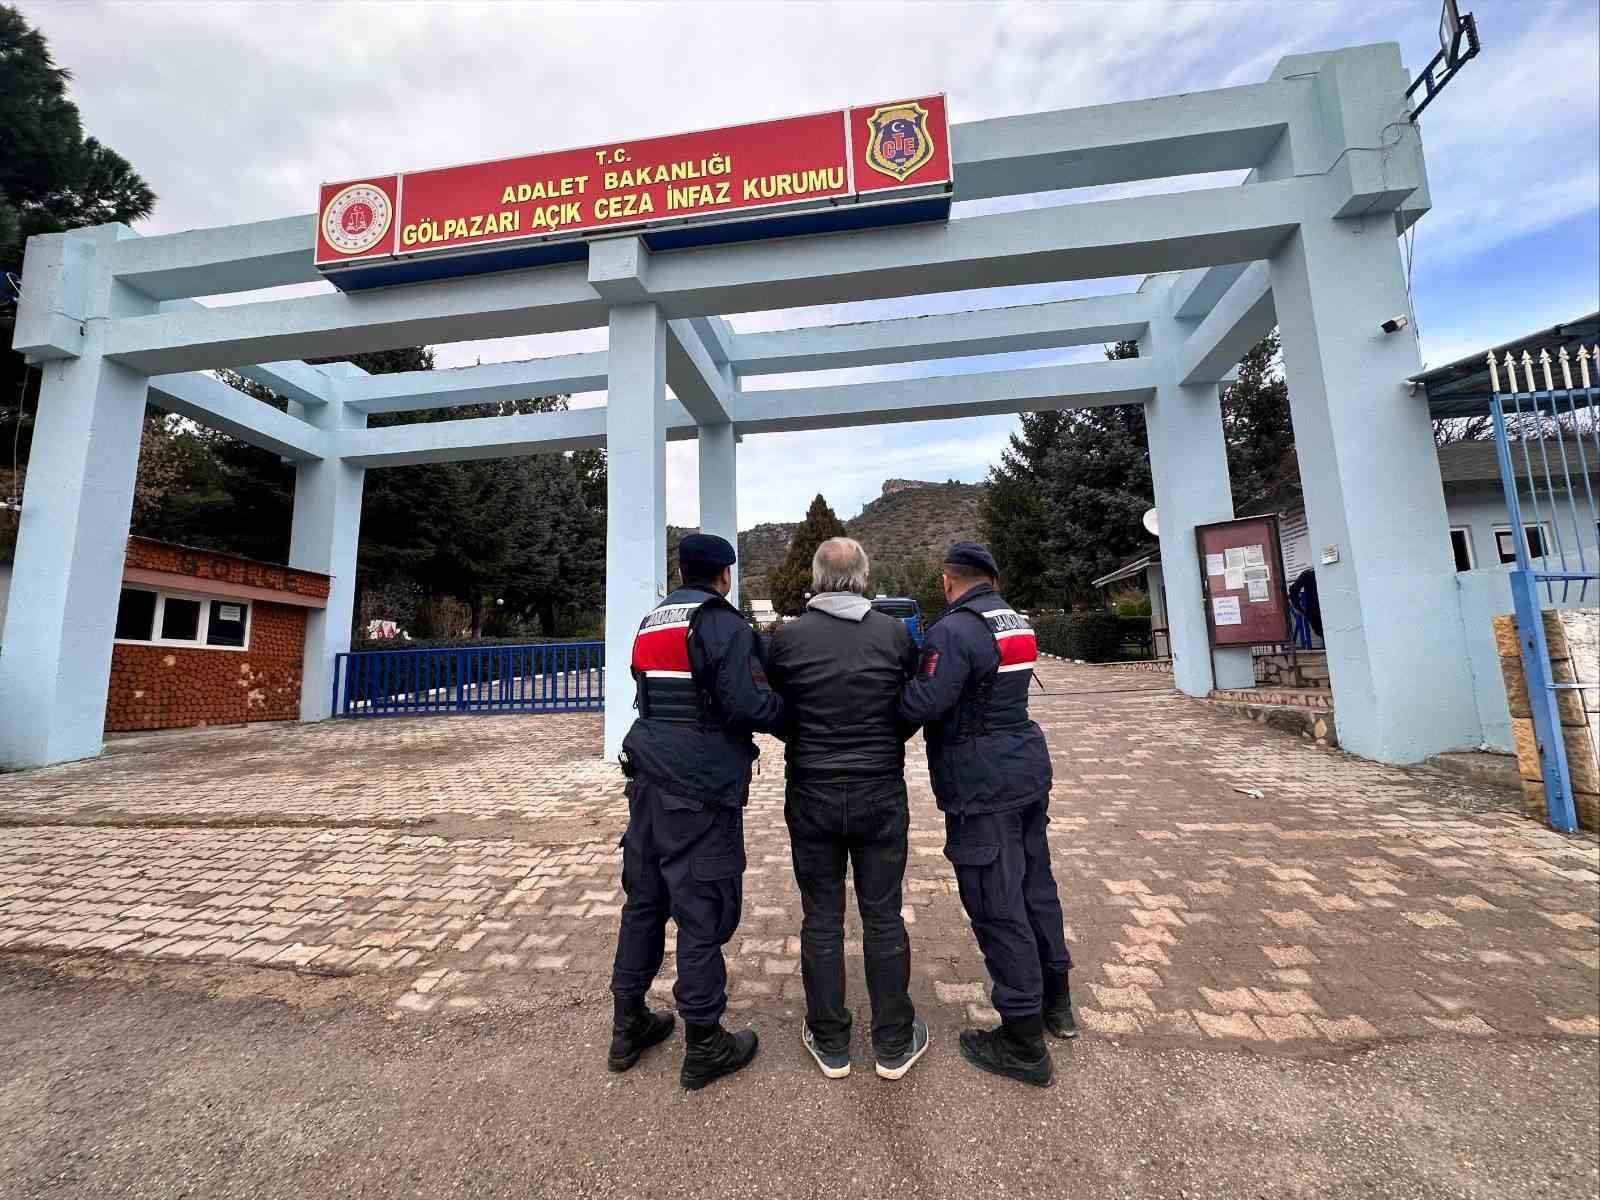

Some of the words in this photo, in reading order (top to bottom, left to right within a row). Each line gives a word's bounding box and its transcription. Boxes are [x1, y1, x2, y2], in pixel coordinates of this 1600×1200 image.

[501, 175, 588, 204] ADALET
[604, 153, 731, 190] BAKANLIĞI
[595, 148, 631, 165] T.C.
[402, 211, 520, 245] GÖLPAZARI
[531, 201, 582, 232] AÇIK
[594, 192, 654, 220] CEZA
[666, 181, 731, 210] İNFAZ
[743, 166, 844, 200] KURUMU
